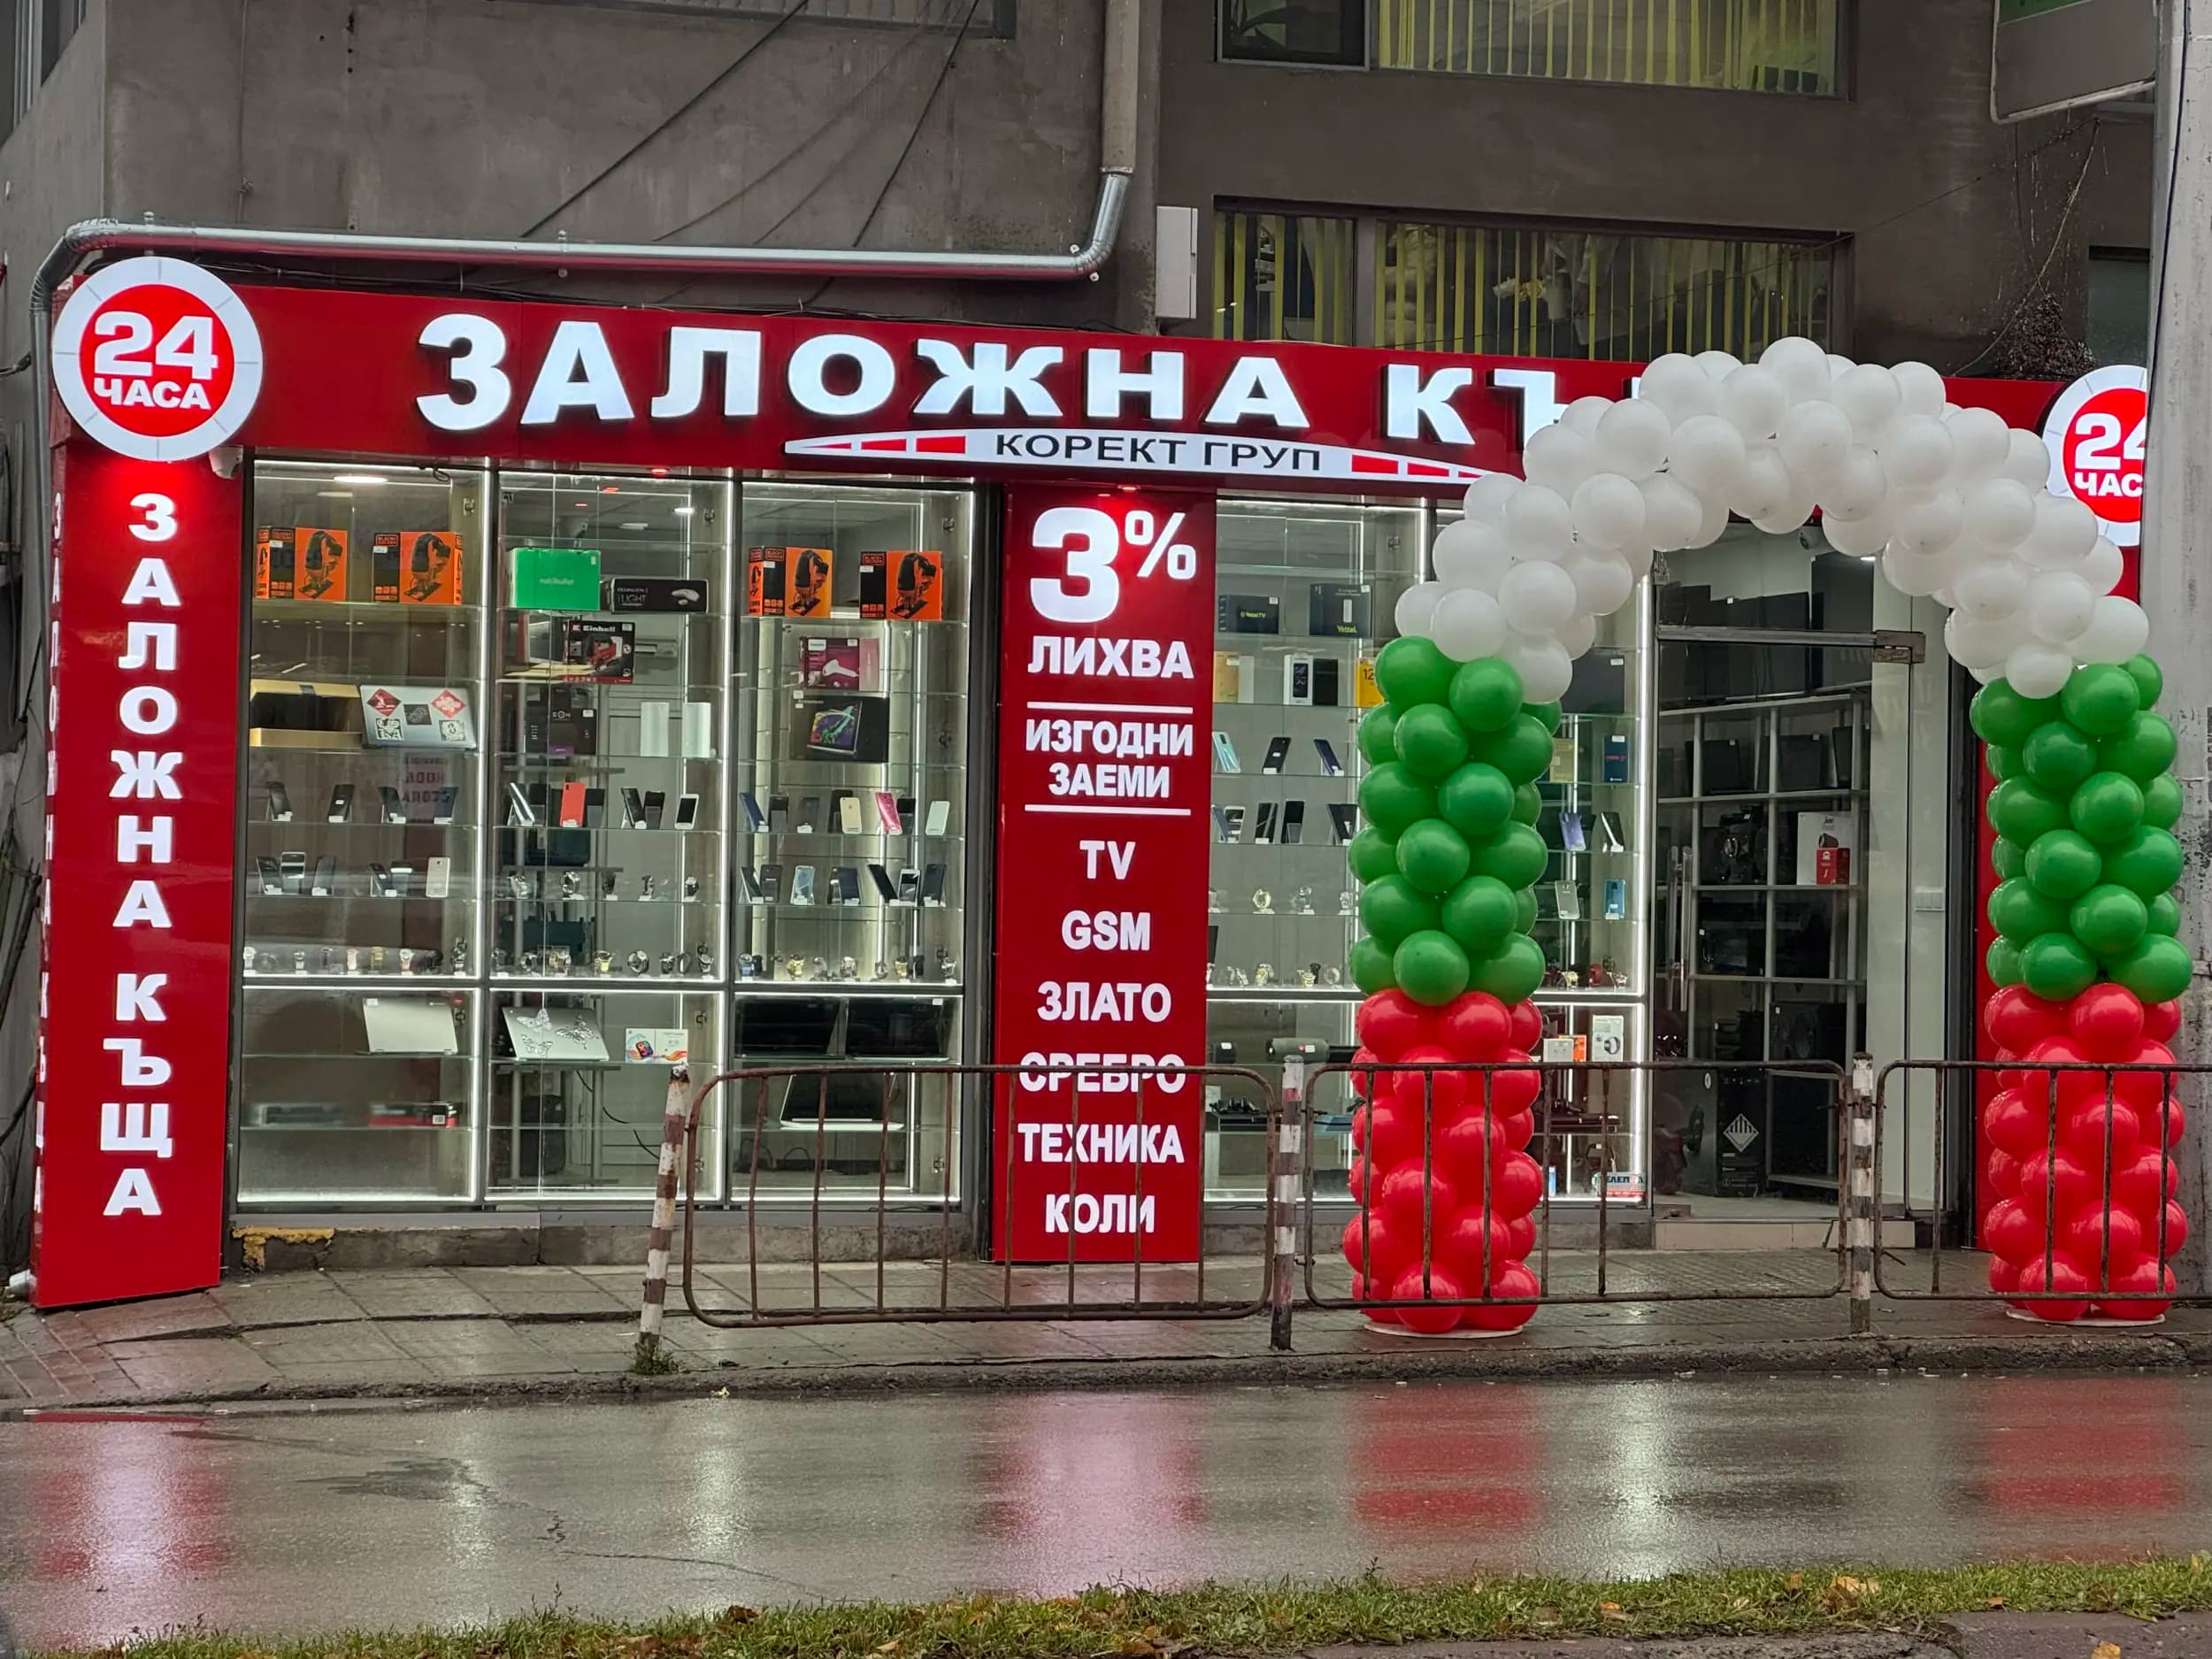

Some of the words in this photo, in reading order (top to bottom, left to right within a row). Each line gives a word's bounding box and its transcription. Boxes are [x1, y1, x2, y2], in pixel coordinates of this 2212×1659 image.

[95, 311, 218, 380] 24
[417, 313, 1310, 431] ЗАЛОЖНА
[94, 378, 211, 410] ЧАСА
[996, 434, 1187, 465] КОРЕКТ
[1204, 442, 1320, 471] ГРУП
[2074, 472, 2143, 496] ЧАС
[1030, 507, 1197, 623] 3%
[1028, 636, 1194, 679] ЛИХВА
[109, 493, 183, 928] ЗАЛОЖНА
[1025, 719, 1193, 759] ИЗГОДНИ
[1048, 762, 1170, 798] ЗАЕМИ
[1079, 840, 1135, 879] TV
[1062, 910, 1150, 950] GSM
[1037, 981, 1171, 1022] ЗЛАТО
[1018, 1052, 1187, 1093] СРЕБРО
[100, 973, 173, 1216] КЪЩА
[1018, 1123, 1184, 1164] ТЕХНИКА
[1045, 1194, 1155, 1233] КОЛИ
